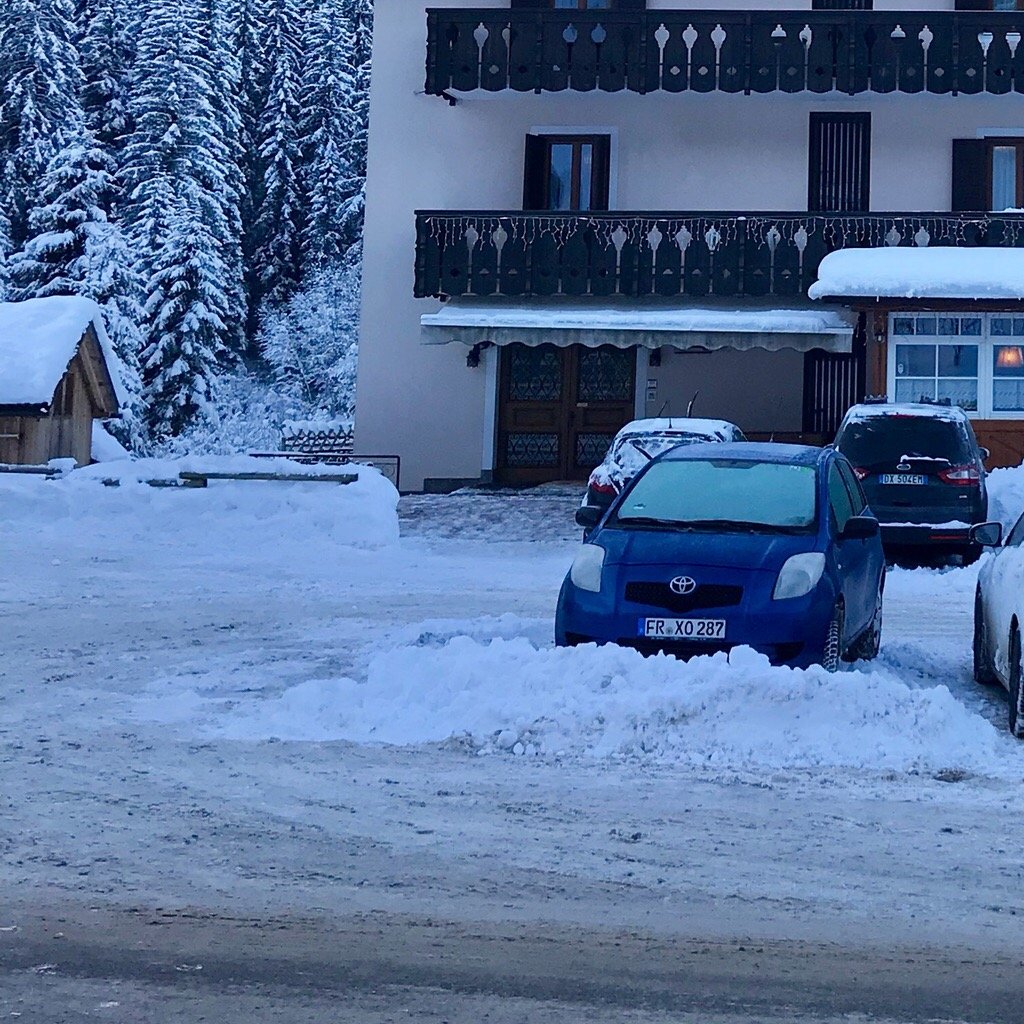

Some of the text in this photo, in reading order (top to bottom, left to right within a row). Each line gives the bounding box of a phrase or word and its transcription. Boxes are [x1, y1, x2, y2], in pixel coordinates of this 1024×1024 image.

[646, 620, 724, 636] FR XO 287
